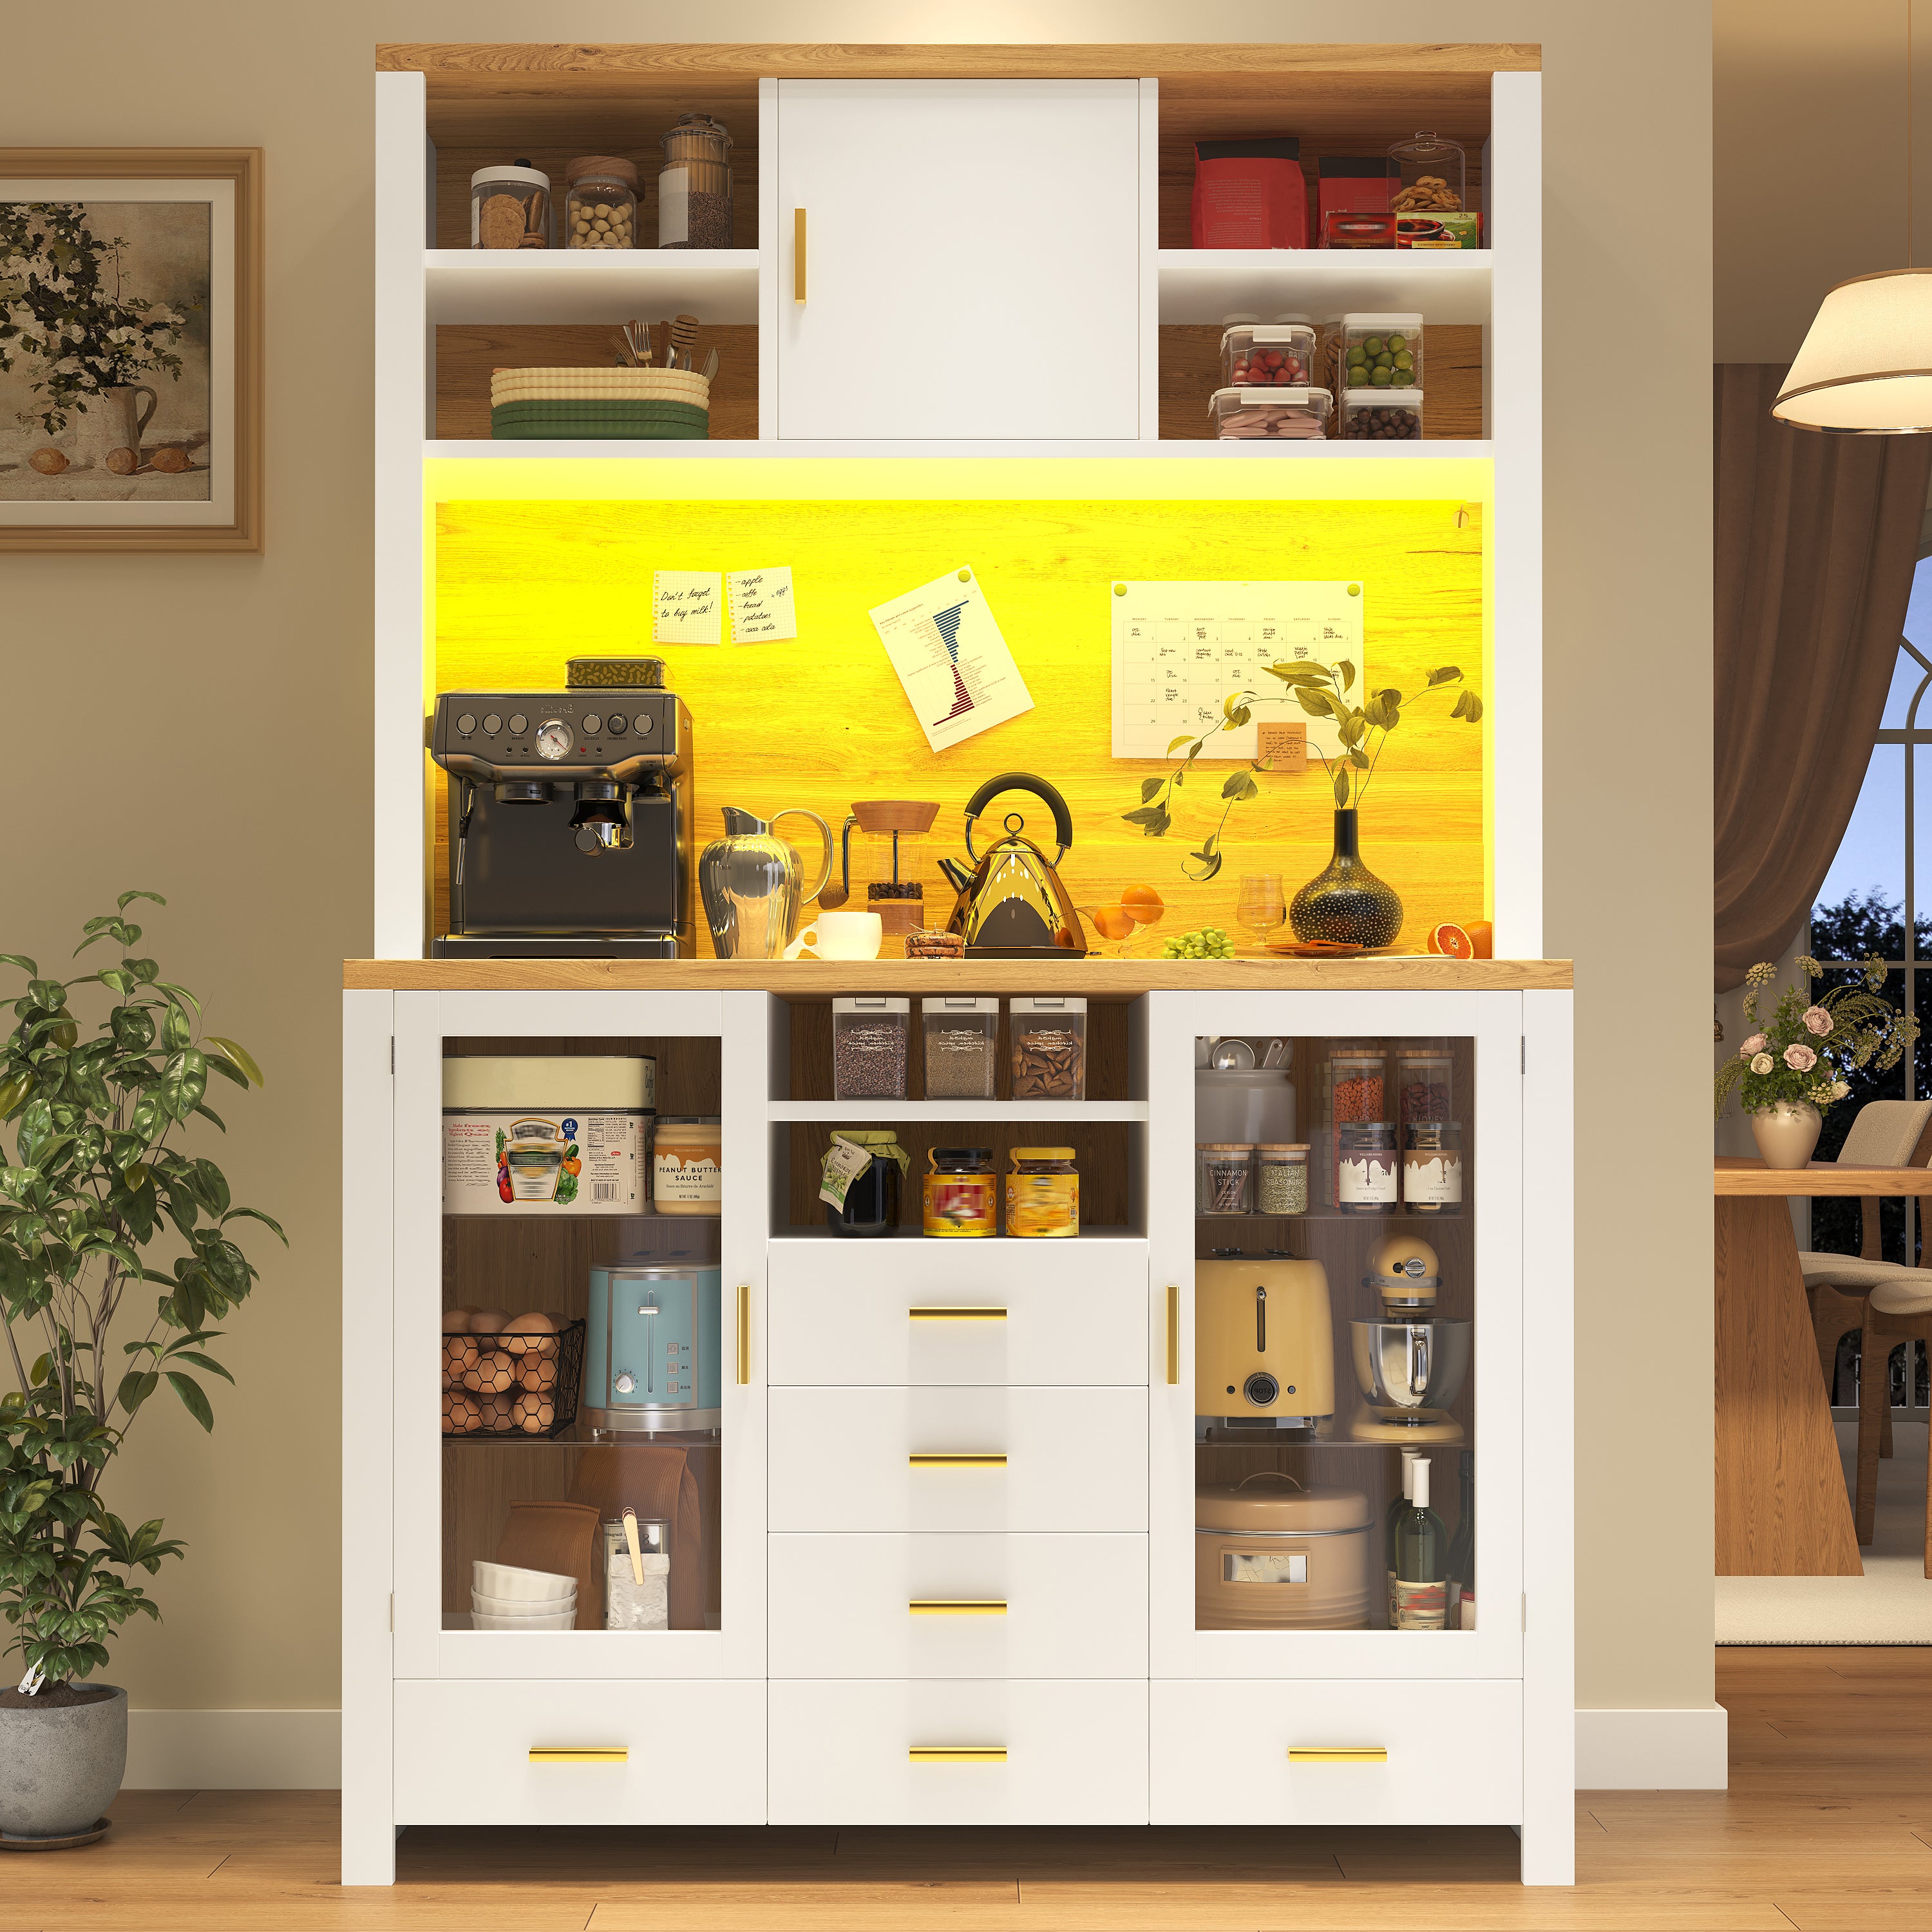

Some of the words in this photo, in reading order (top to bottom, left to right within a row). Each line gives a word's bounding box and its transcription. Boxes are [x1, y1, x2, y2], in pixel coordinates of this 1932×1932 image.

[661, 591, 683, 601] Don't
[687, 587, 710, 600] forget
[661, 609, 670, 618] to
[674, 608, 688, 621] buy
[690, 601, 714, 615] milk!
